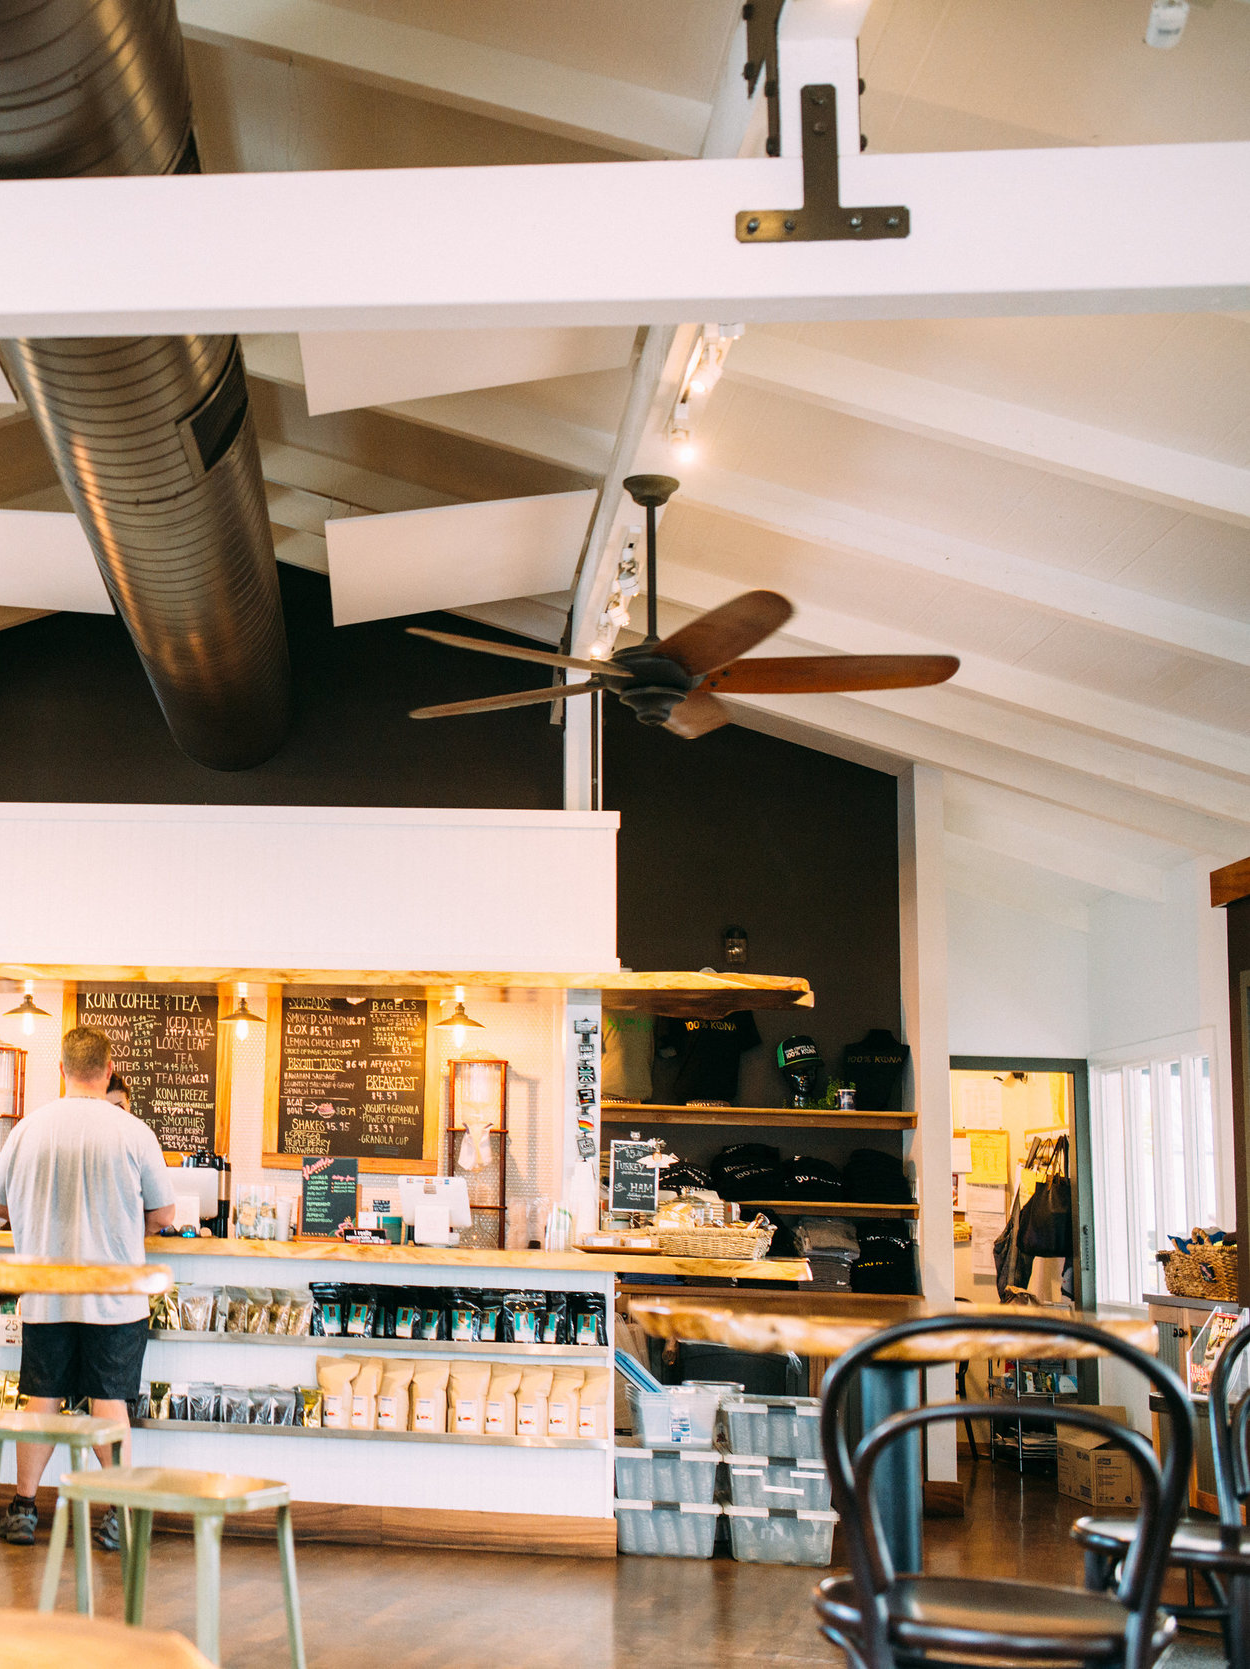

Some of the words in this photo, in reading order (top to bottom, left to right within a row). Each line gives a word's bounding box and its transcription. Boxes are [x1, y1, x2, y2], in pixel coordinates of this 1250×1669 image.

[86, 992, 118, 1009] KONA
[120, 992, 161, 1010] COFFEE
[171, 994, 202, 1013] TEA
[372, 1001, 417, 1011] BAGELS
[102, 1014, 130, 1027] KONA
[166, 1016, 189, 1030] ICED
[190, 1017, 213, 1031] TEA
[286, 1012, 317, 1025] SMOKED
[318, 1014, 350, 1026] SALMON
[105, 1029, 130, 1041] KONA
[287, 1025, 308, 1035] LOX
[156, 1036, 184, 1051] LOOSE
[187, 1037, 211, 1051] LEAF
[285, 1036, 310, 1048] LEMON
[310, 1038, 343, 1049] CHICKEN
[174, 1053, 194, 1064] TEA
[370, 1060, 412, 1069] AFFAGATO
[113, 1061, 133, 1072] HITE
[155, 1072, 175, 1084] TEA
[175, 1073, 192, 1085] BAG
[366, 1074, 419, 1090] BREAKFAST
[155, 1087, 179, 1101] KONA
[180, 1089, 209, 1102] FREEZE
[286, 1107, 304, 1115] BOWL
[362, 1103, 387, 1115] YOGURT
[391, 1104, 420, 1115] GRANOLA
[161, 1115, 206, 1129] SMOOTHIES
[291, 1118, 326, 1131] SHAKES
[363, 1113, 386, 1123] POWER
[387, 1115, 417, 1126] OATMEAL
[161, 1127, 183, 1135] TRIPLE
[184, 1127, 204, 1135] BERRY
[284, 1130, 321, 1140] ESPRESSO
[160, 1134, 190, 1142] TROPICAL
[190, 1136, 209, 1145] FRUIT
[284, 1138, 307, 1148] TRIPLE
[360, 1134, 394, 1145] GRANOLA
[395, 1136, 410, 1146] CUP
[630, 1182, 653, 1194] HAM
